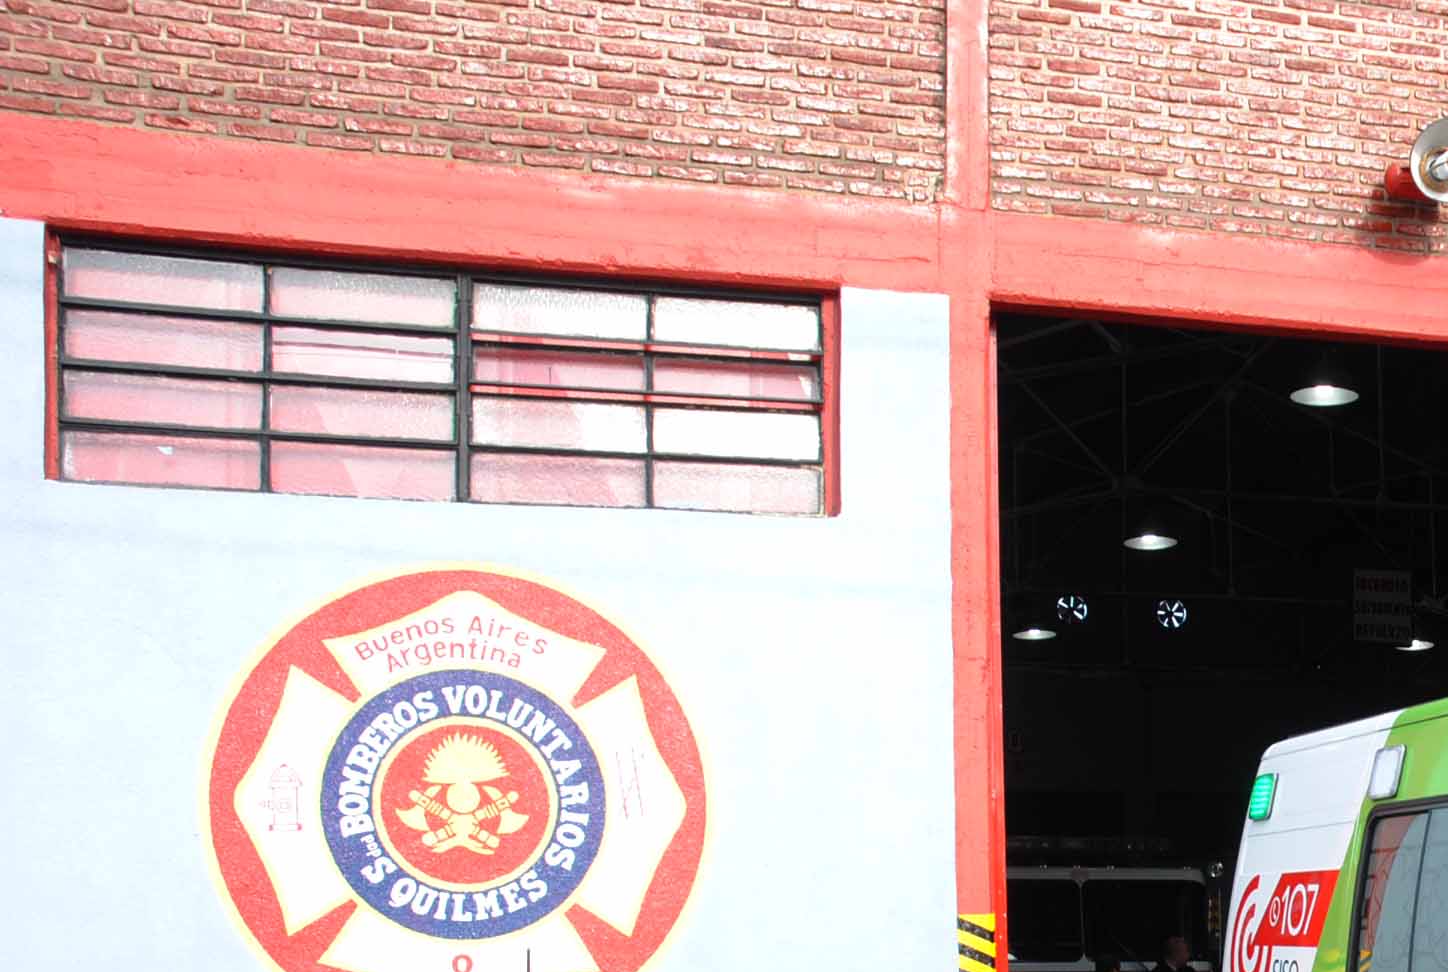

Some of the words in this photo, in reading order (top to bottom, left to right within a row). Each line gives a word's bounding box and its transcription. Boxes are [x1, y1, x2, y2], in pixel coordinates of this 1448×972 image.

[354, 617, 454, 660] Buenos
[468, 616, 547, 654] Aires
[386, 639, 520, 672] Argentina
[339, 691, 438, 838] BOMBEROS
[442, 685, 590, 871] VOLUNTARIOS
[389, 870, 548, 921] QUILMES
[1281, 884, 1320, 936] 107
